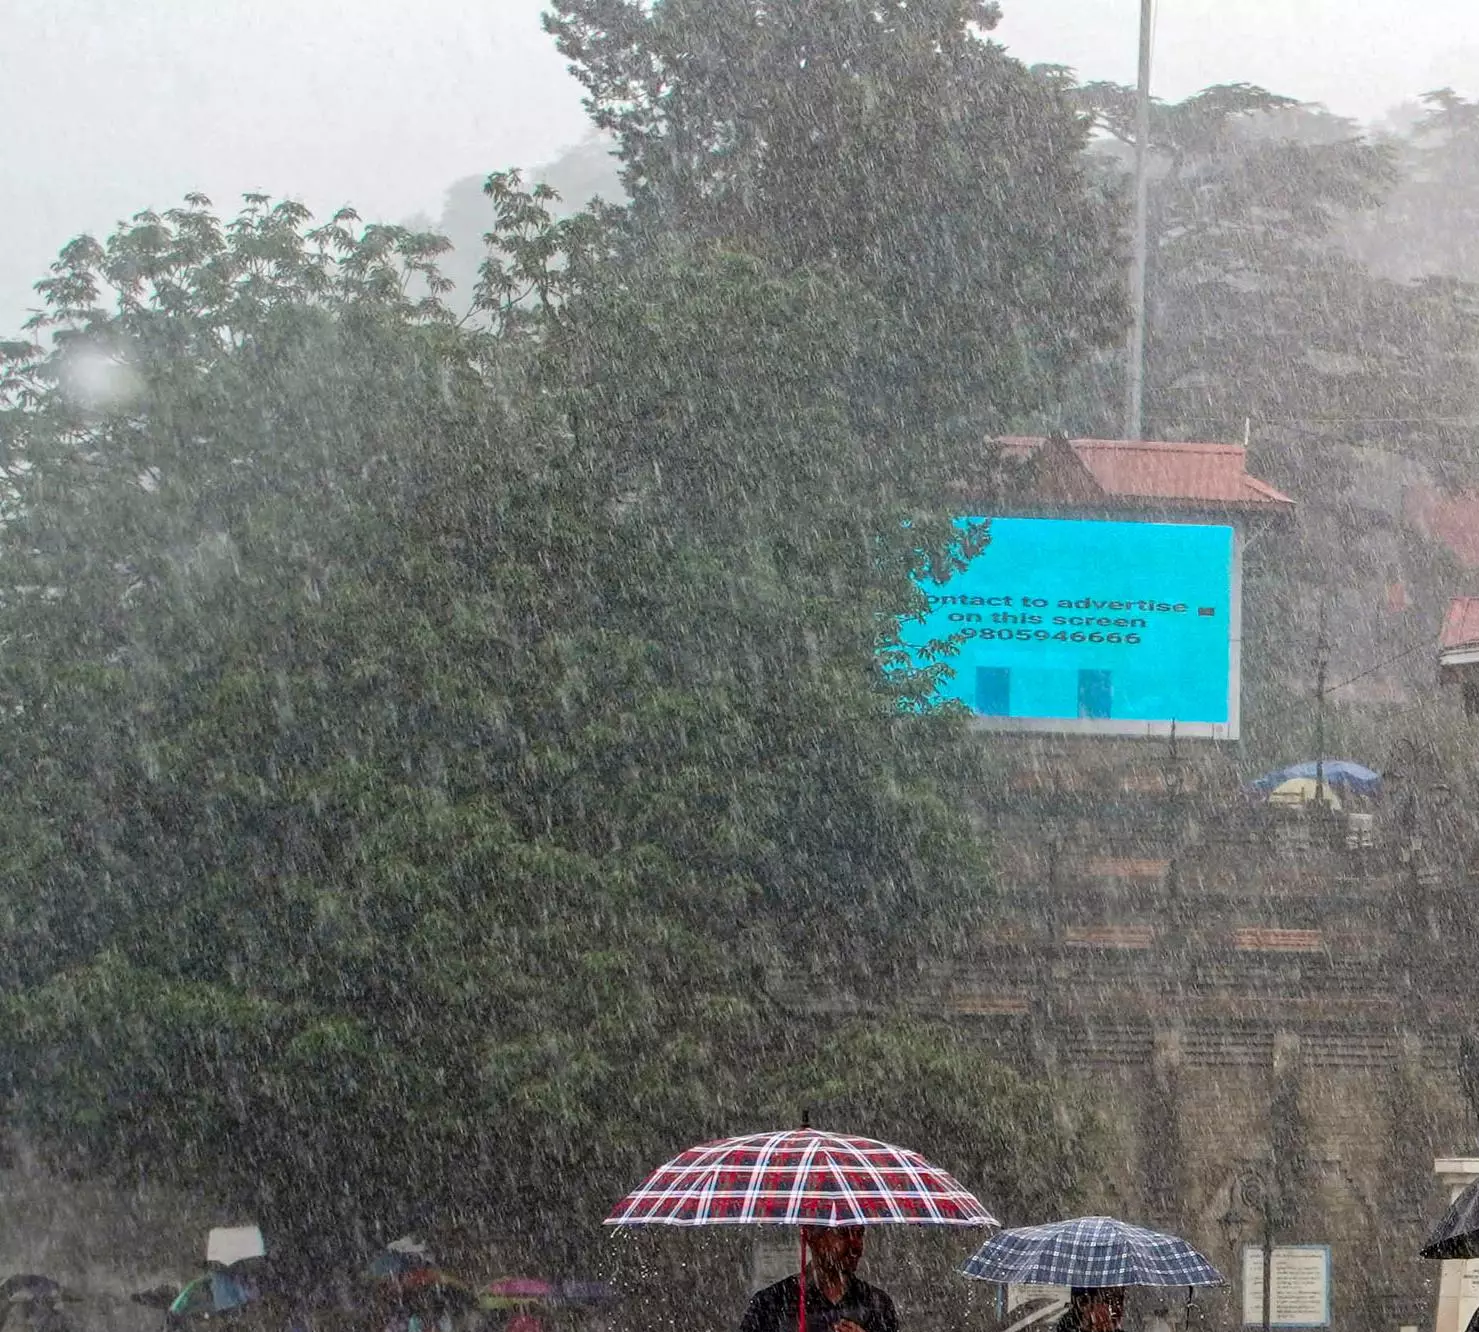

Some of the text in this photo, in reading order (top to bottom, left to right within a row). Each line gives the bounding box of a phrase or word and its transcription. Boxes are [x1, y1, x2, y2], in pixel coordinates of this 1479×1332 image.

[926, 594, 1188, 613] ontact to advertise
[948, 611, 1147, 628] on this screen
